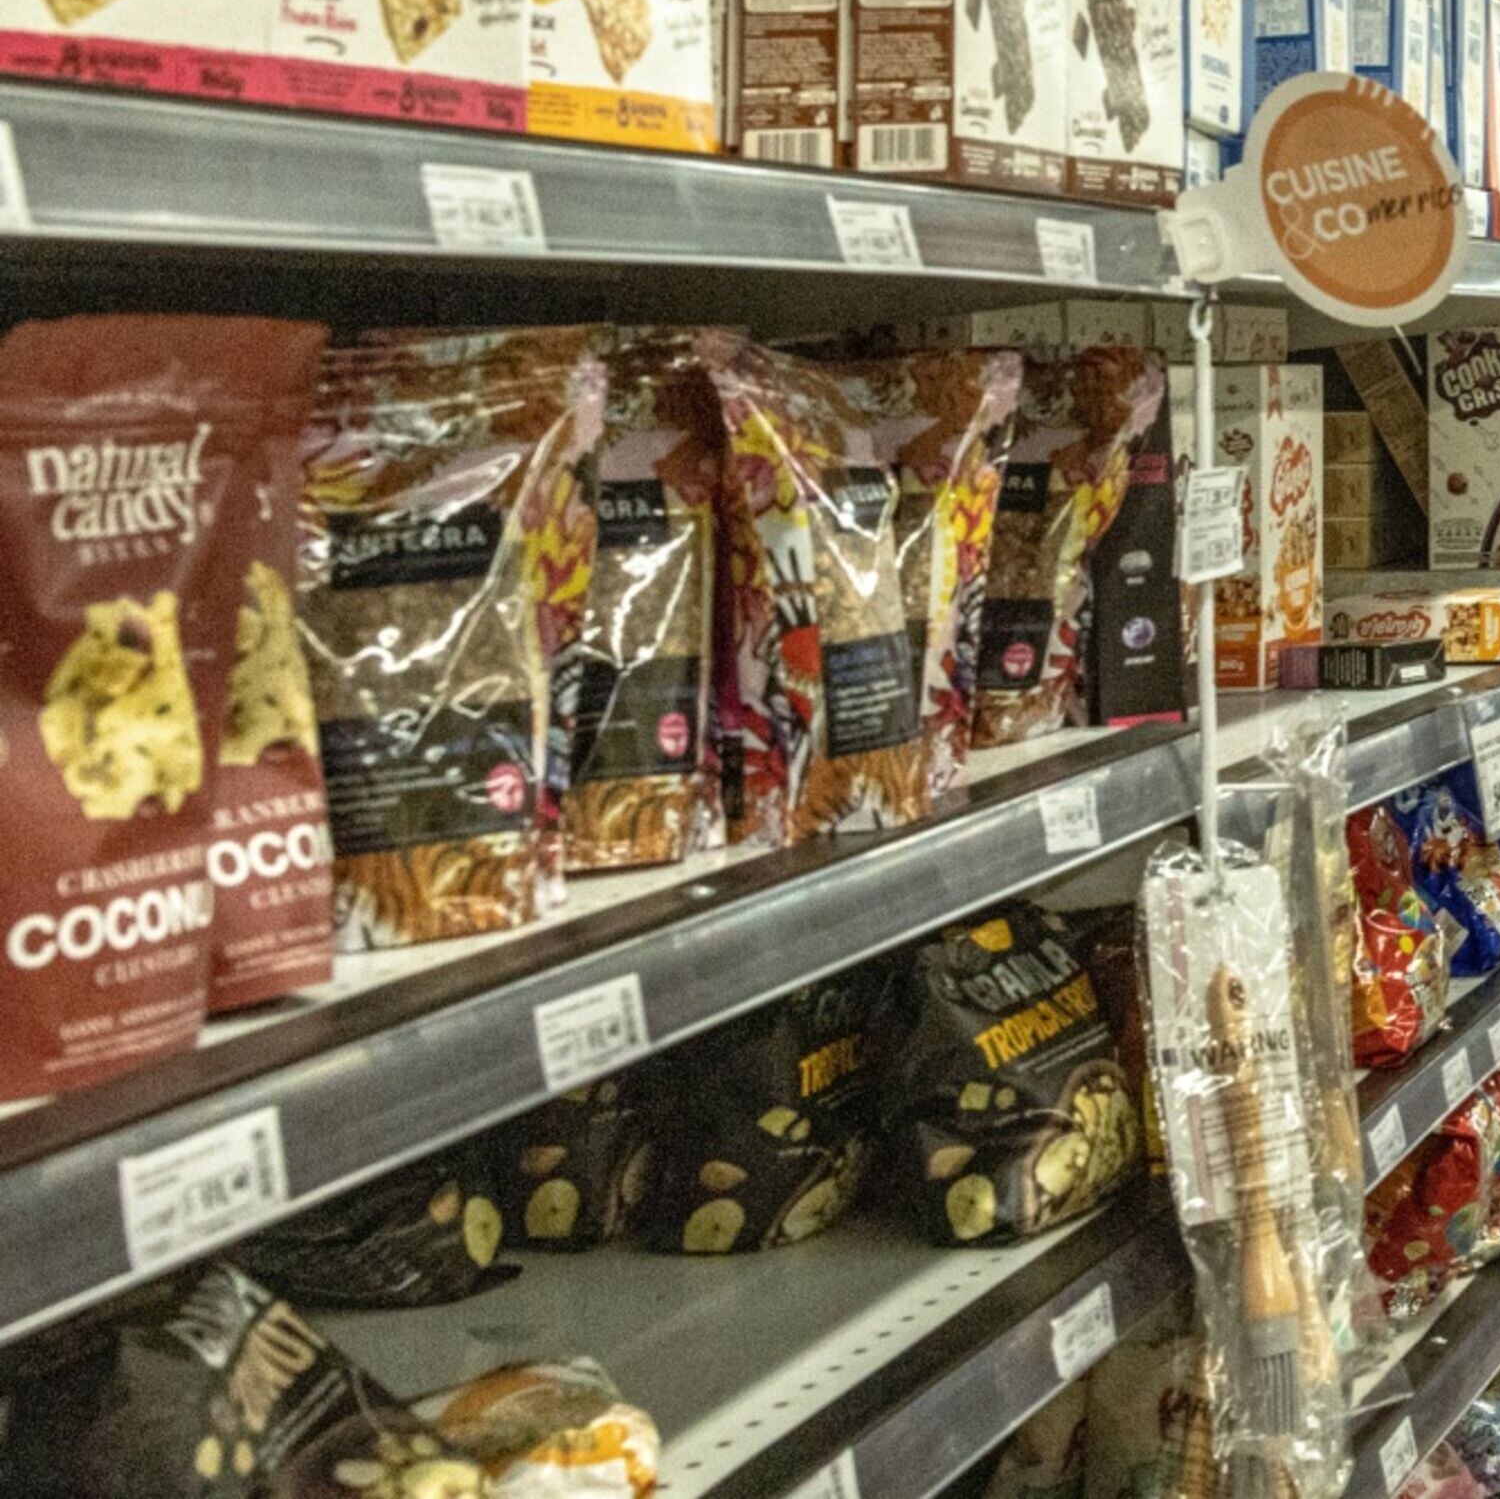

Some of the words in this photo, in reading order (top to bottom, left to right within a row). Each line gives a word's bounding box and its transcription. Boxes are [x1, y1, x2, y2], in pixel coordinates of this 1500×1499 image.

[1267, 145, 1408, 204] CUISINE
[27, 421, 213, 495] natural
[51, 479, 198, 544] candy
